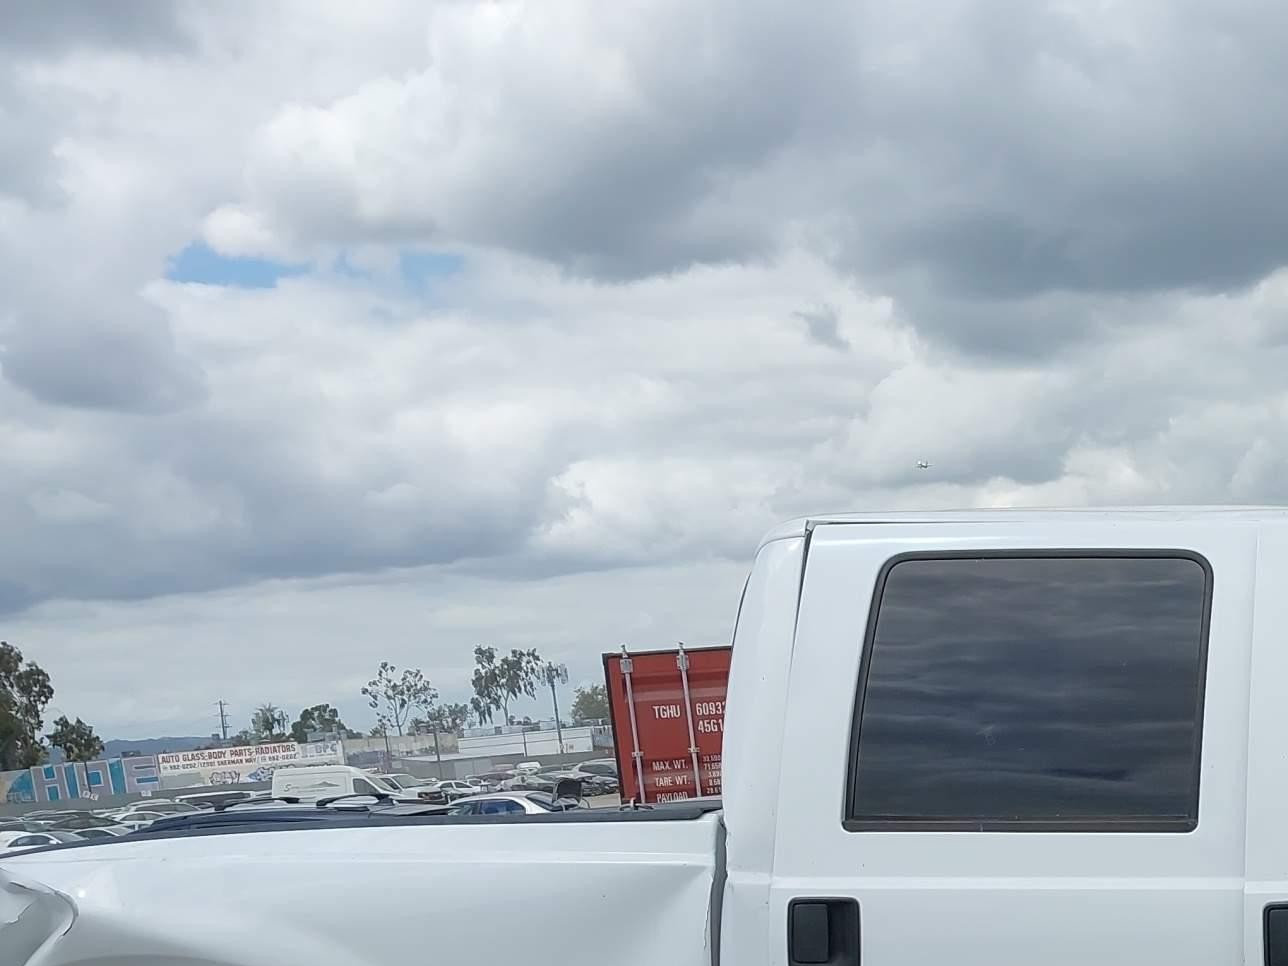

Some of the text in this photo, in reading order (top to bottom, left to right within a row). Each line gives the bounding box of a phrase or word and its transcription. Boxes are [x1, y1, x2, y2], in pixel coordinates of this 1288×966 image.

[652, 701, 726, 719] TGHU 6093
[161, 755, 179, 764] AUTO
[652, 761, 672, 771] MAX.
[673, 760, 689, 769] WT.
[655, 776, 673, 787] TARE
[675, 775, 690, 785] WT.
